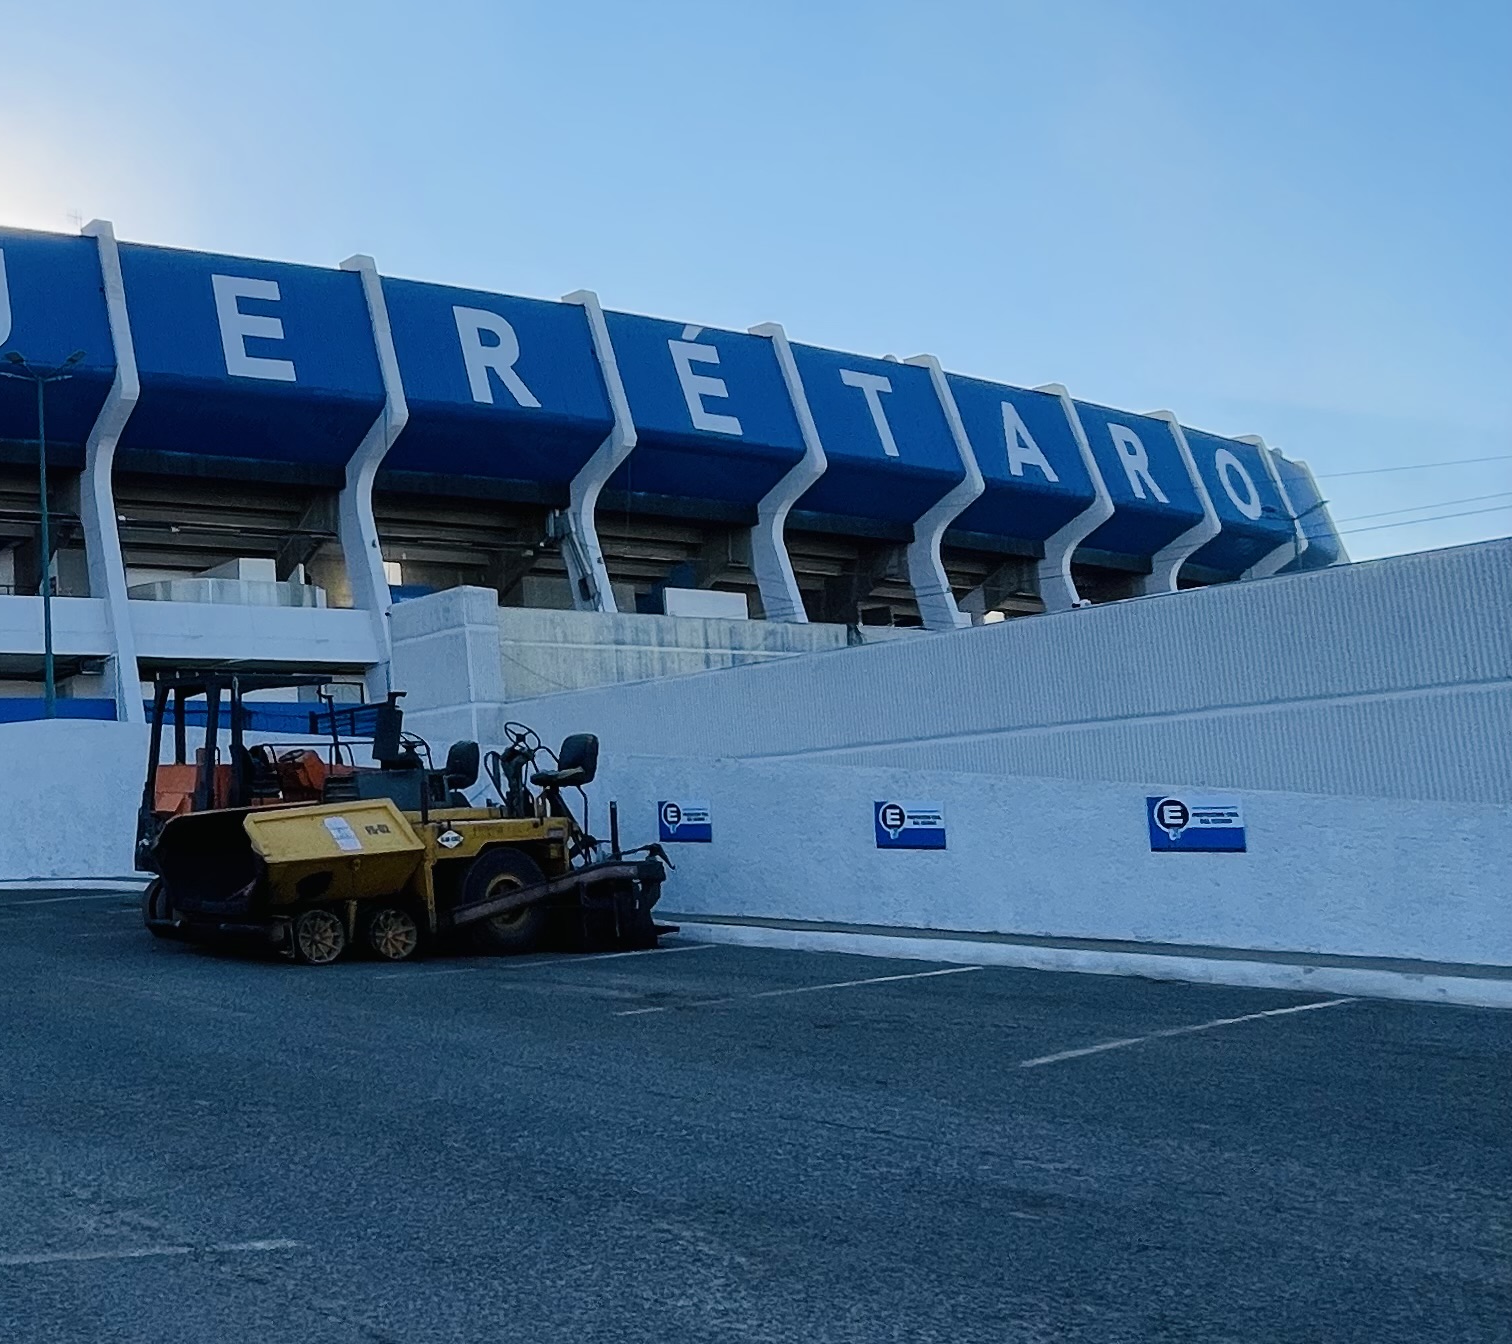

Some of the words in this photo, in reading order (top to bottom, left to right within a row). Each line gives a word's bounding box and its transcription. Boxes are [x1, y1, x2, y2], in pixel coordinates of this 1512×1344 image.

[667, 807, 678, 822] E
[886, 808, 902, 825] E
[1163, 805, 1184, 825] E
